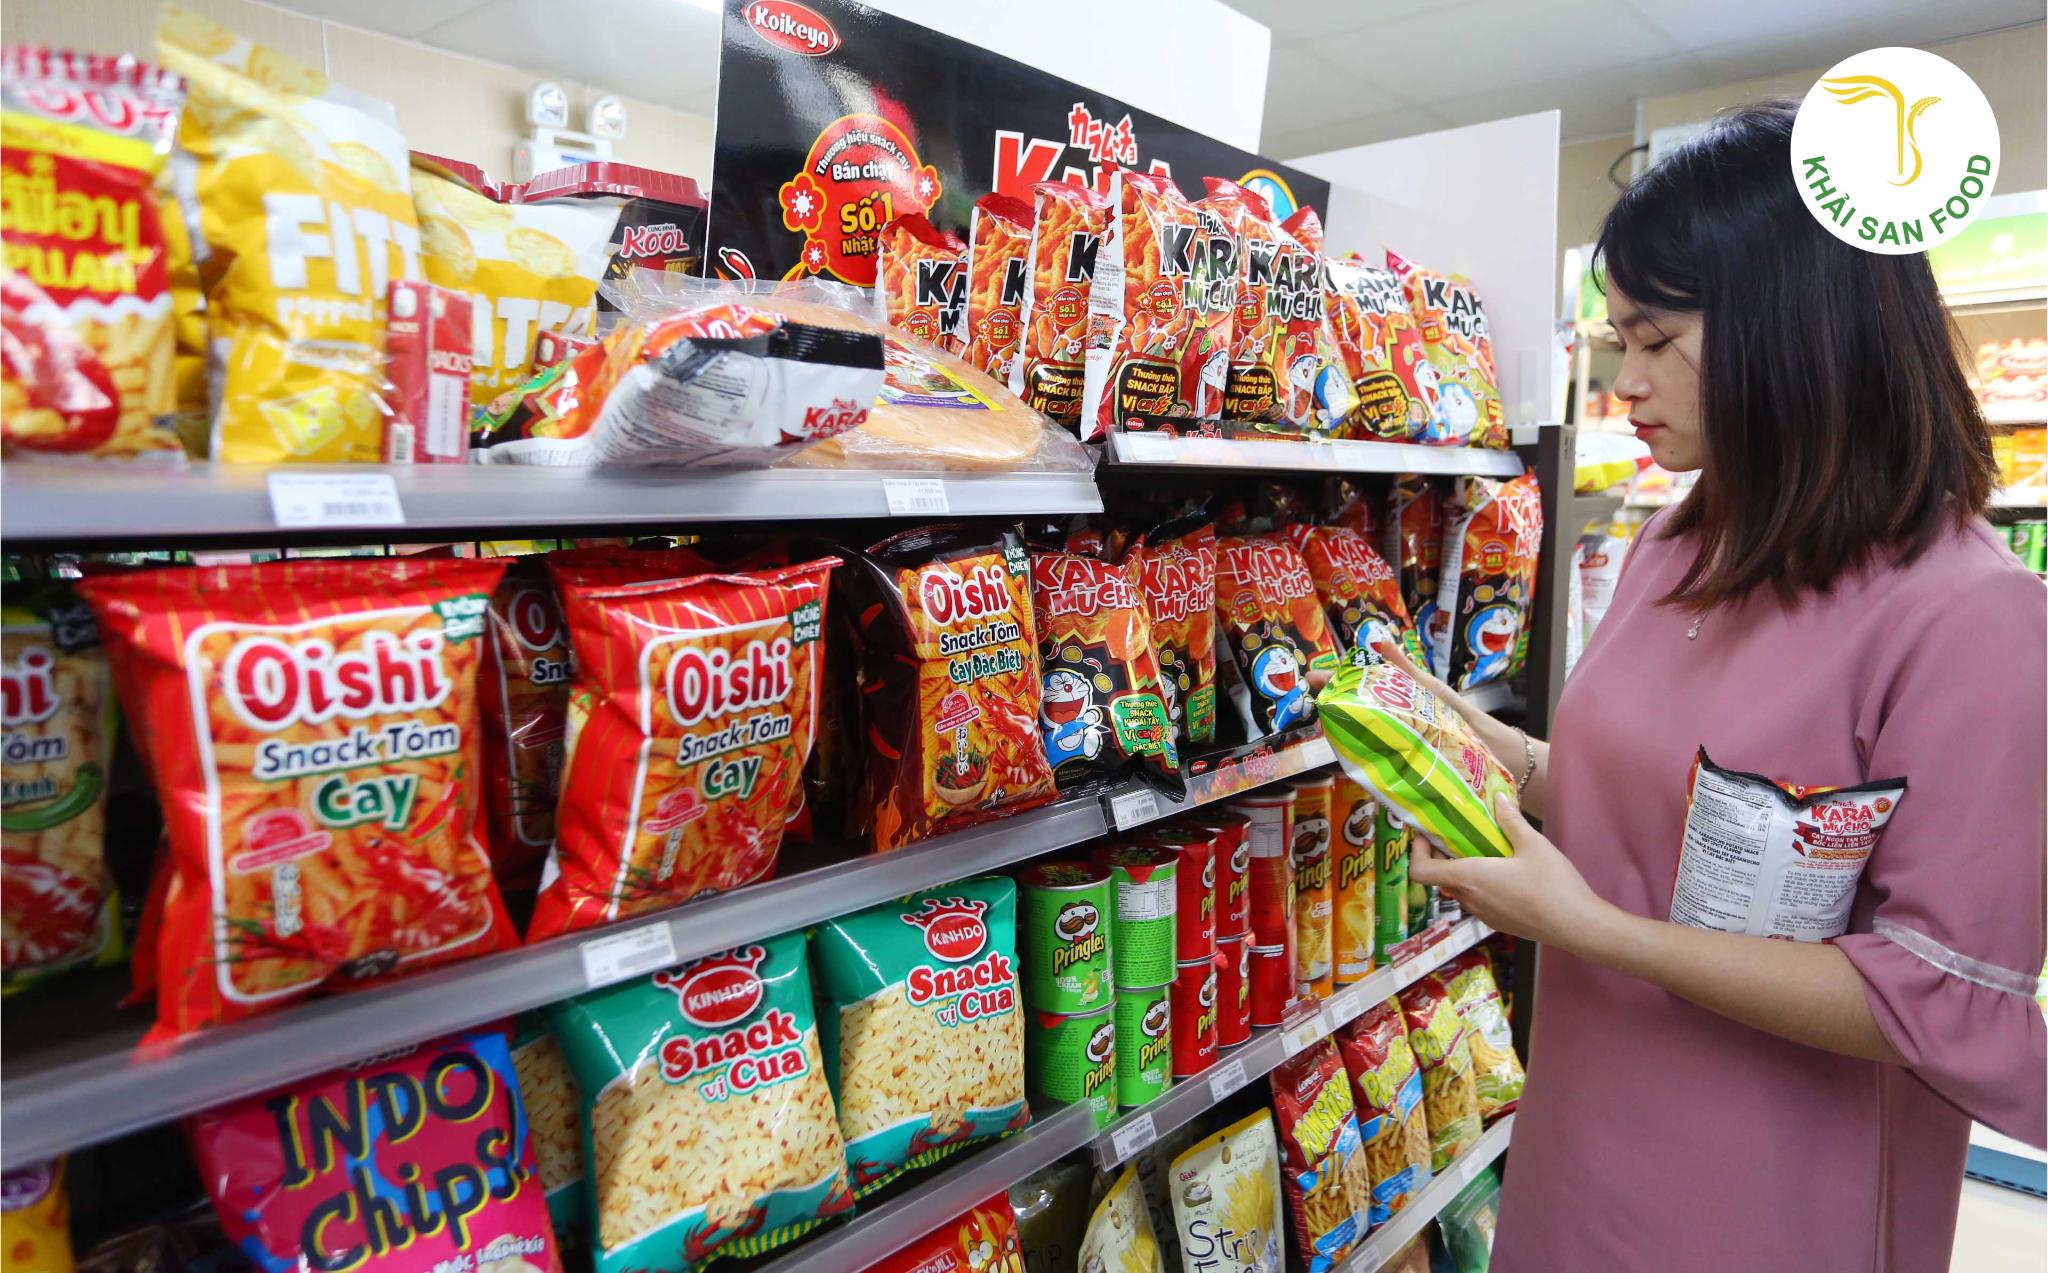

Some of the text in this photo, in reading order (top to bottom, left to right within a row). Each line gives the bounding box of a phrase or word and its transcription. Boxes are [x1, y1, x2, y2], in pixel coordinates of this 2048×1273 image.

[755, 5, 829, 48] Koikeya
[1068, 102, 1138, 165] カラムチョ
[816, 130, 912, 175] Thương hiệu snack cay
[833, 161, 895, 182] Bán chạy
[621, 227, 689, 256] KOOL
[841, 238, 875, 257] Nhật
[1127, 379, 1158, 393] SNACK
[1132, 367, 1161, 382] Thưởng
[1230, 384, 1257, 394] SNACK
[803, 406, 868, 431] KARA
[1122, 394, 1138, 412] Vị
[1225, 398, 1236, 413] Vị
[1227, 542, 1309, 585] KARA
[924, 569, 1009, 624] Oishi
[1155, 582, 1216, 622] MUCHO
[1257, 571, 1314, 604] MUCHO
[940, 622, 1019, 653] Snack Tôm
[235, 635, 446, 723] Oishi
[671, 642, 790, 722] Oishi
[950, 647, 1022, 684] Cay Đặc Biệt
[1129, 709, 1154, 717] SNACK
[1147, 717, 1161, 726] TÂY
[262, 721, 457, 773] Snack Tôm
[680, 714, 790, 762] Snack Tôm
[1124, 729, 1137, 742] Vị
[704, 756, 761, 799] Cay
[316, 774, 417, 831] Cay
[1811, 804, 1875, 822] KARA
[1822, 821, 1871, 834] MUCHO
[1053, 931, 1105, 976] Pringles
[909, 952, 1013, 1002] Snack
[1055, 976, 1077, 985] SOUR
[1057, 981, 1082, 989] CREAM
[938, 989, 1014, 1025] vị Cua
[660, 1011, 800, 1079] Snack
[703, 1050, 805, 1099] vị Cua
[266, 1051, 495, 1191] INDO
[1179, 1169, 1198, 1182] Oishi
